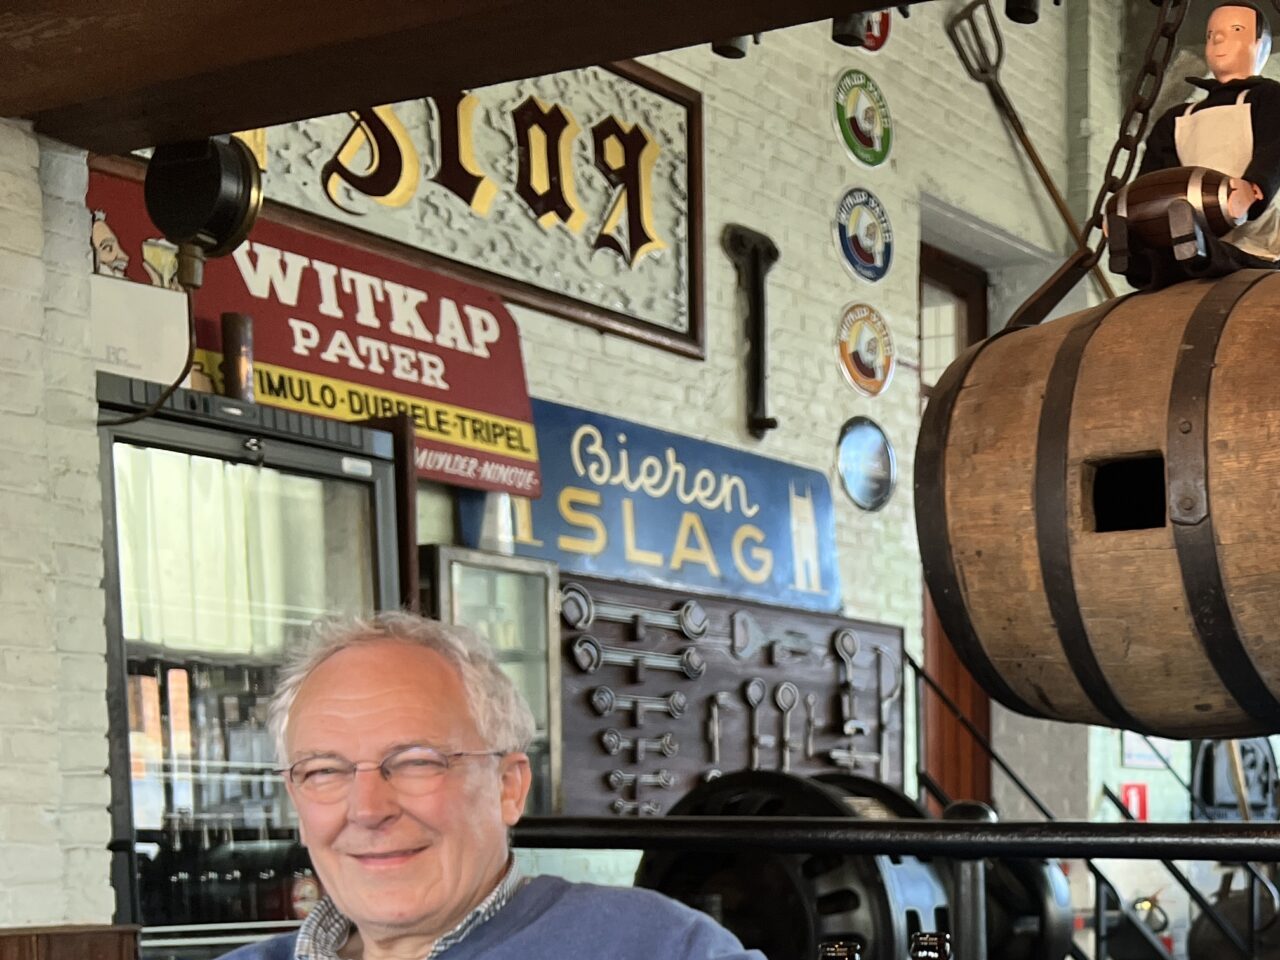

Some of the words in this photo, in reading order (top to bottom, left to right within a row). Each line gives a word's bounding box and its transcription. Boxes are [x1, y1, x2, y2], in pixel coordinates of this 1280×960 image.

[232, 240, 500, 358] WITKAP
[288, 318, 450, 390] PATER
[571, 424, 759, 517] Bieren
[557, 486, 773, 584] SLAG
